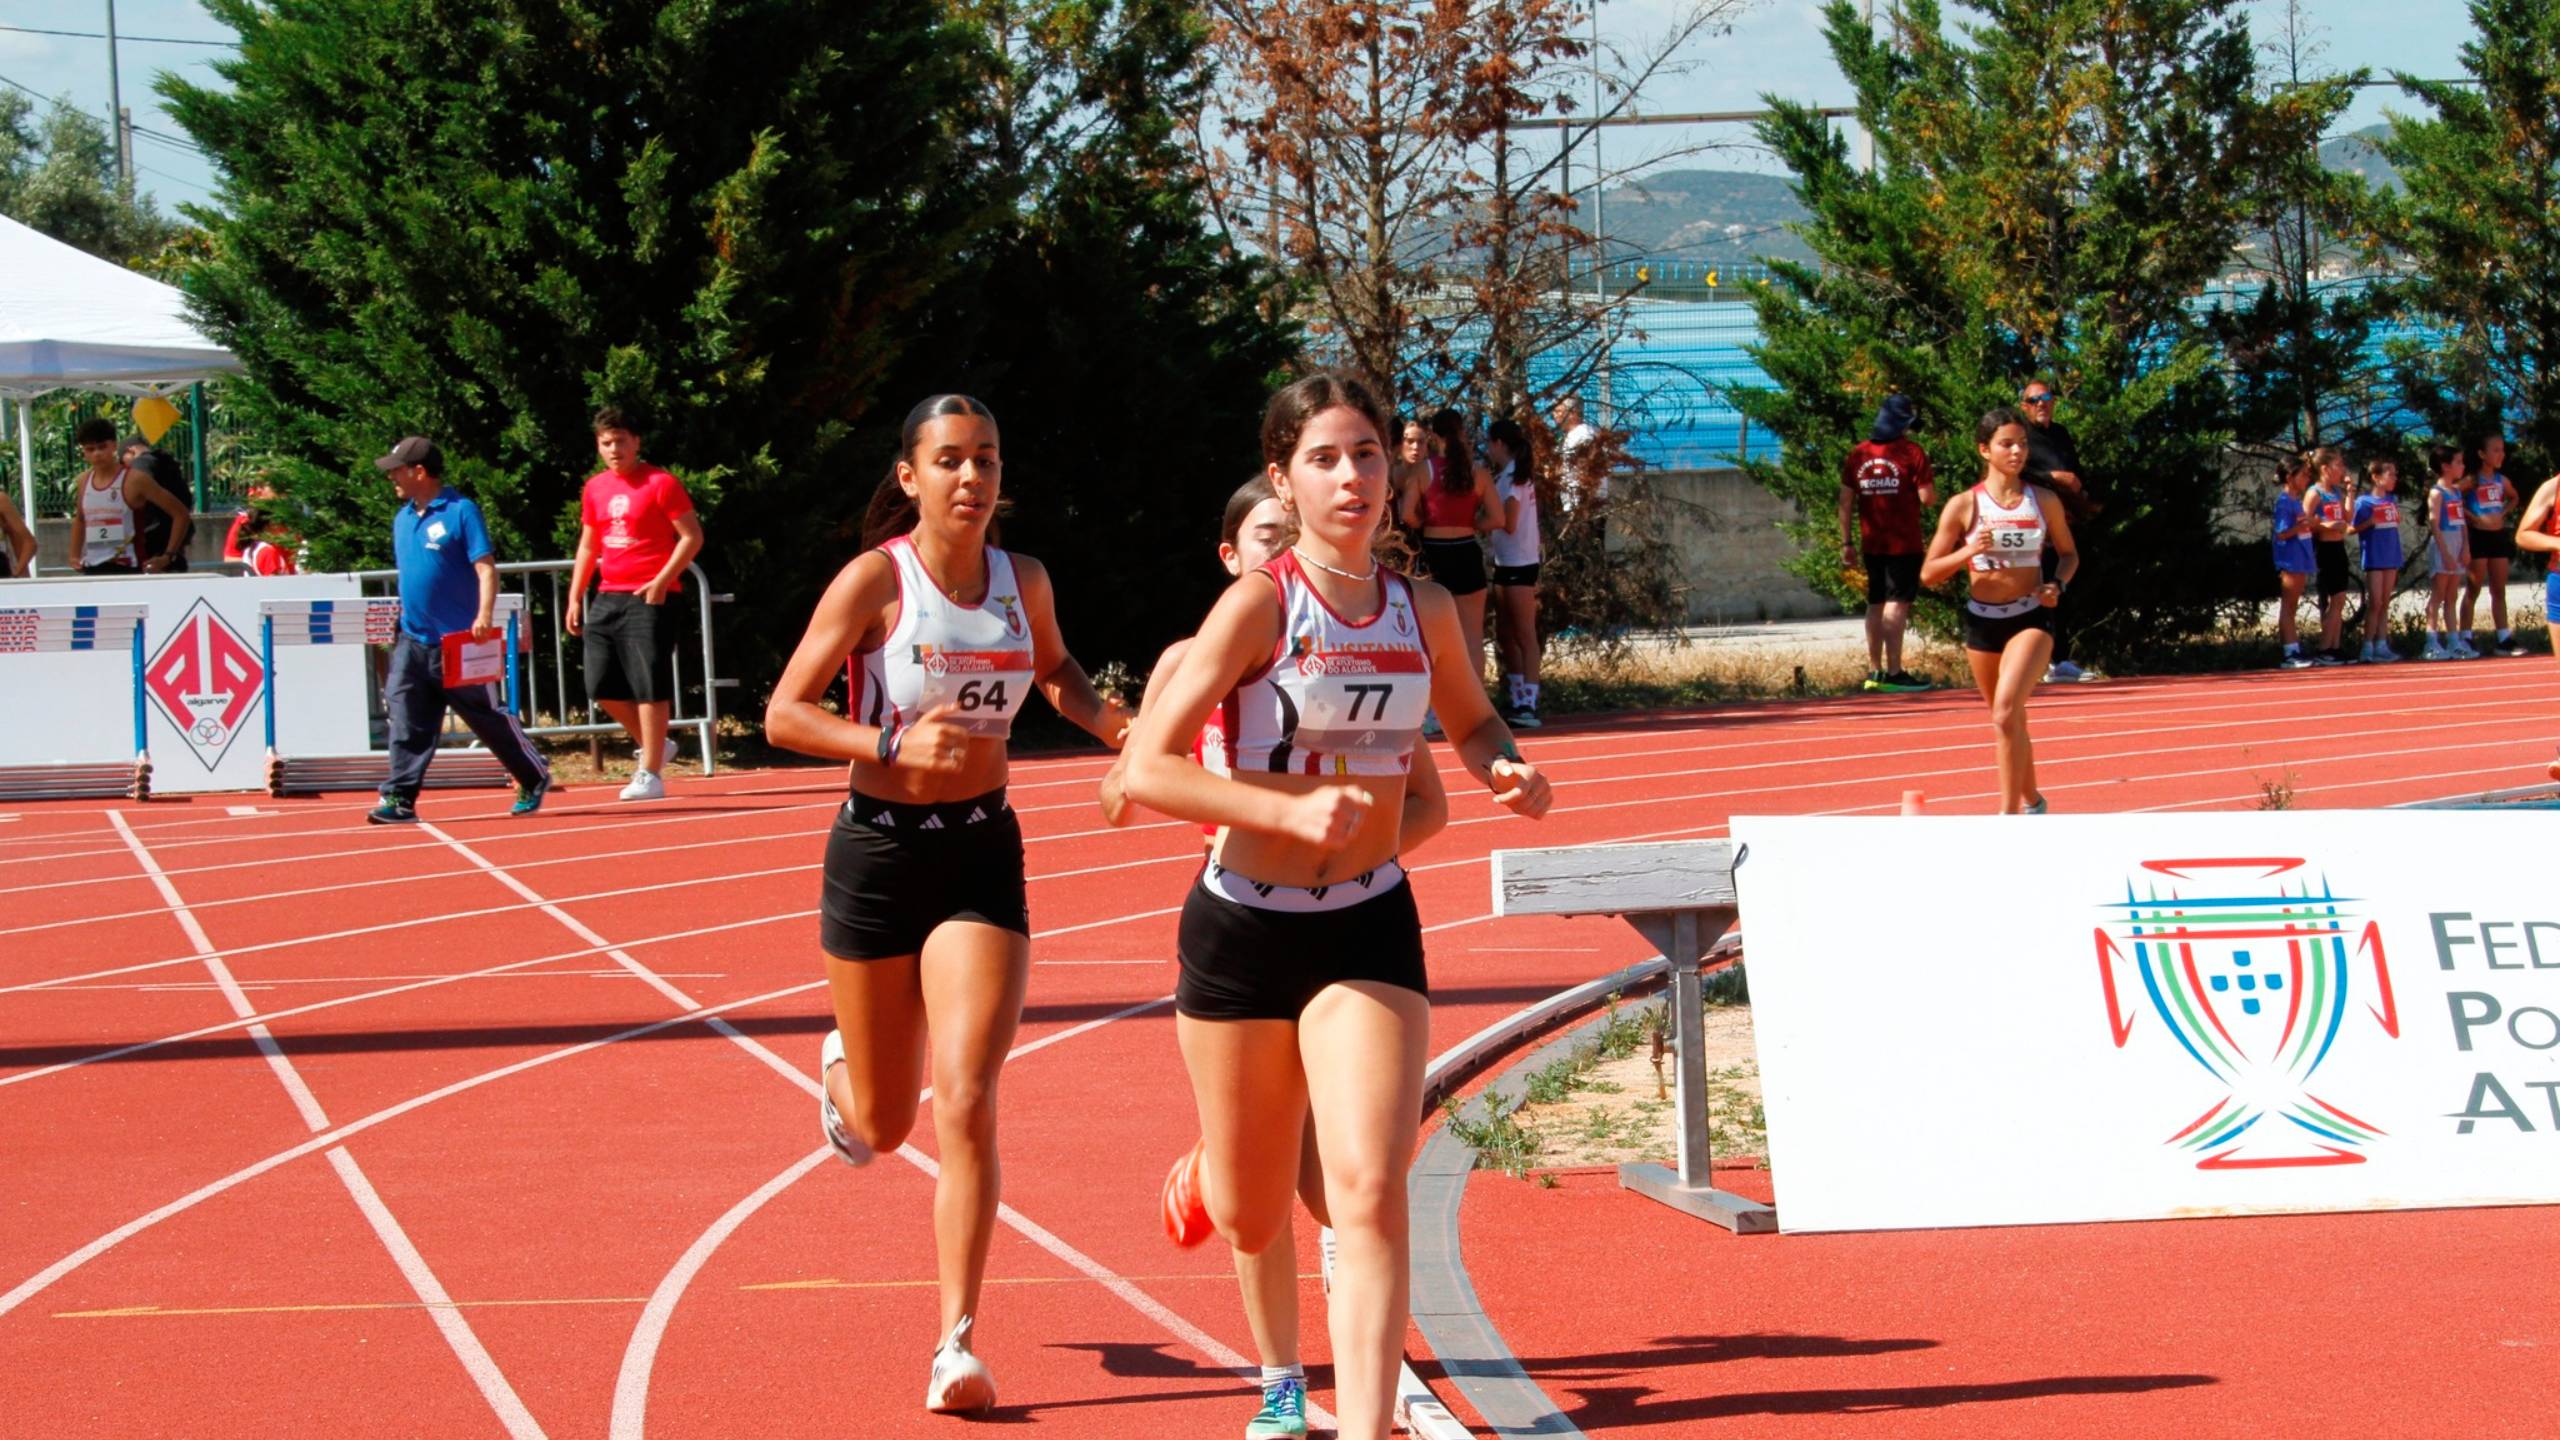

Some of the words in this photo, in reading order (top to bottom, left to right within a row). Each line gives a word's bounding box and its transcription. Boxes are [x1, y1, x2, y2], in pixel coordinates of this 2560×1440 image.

[100, 528, 108, 539] 2
[2001, 533, 2025, 548] 53
[1341, 665, 1377, 673] ALGARVE
[187, 697, 228, 707] algarve
[957, 680, 1008, 713] 64
[1344, 684, 1393, 721] 77
